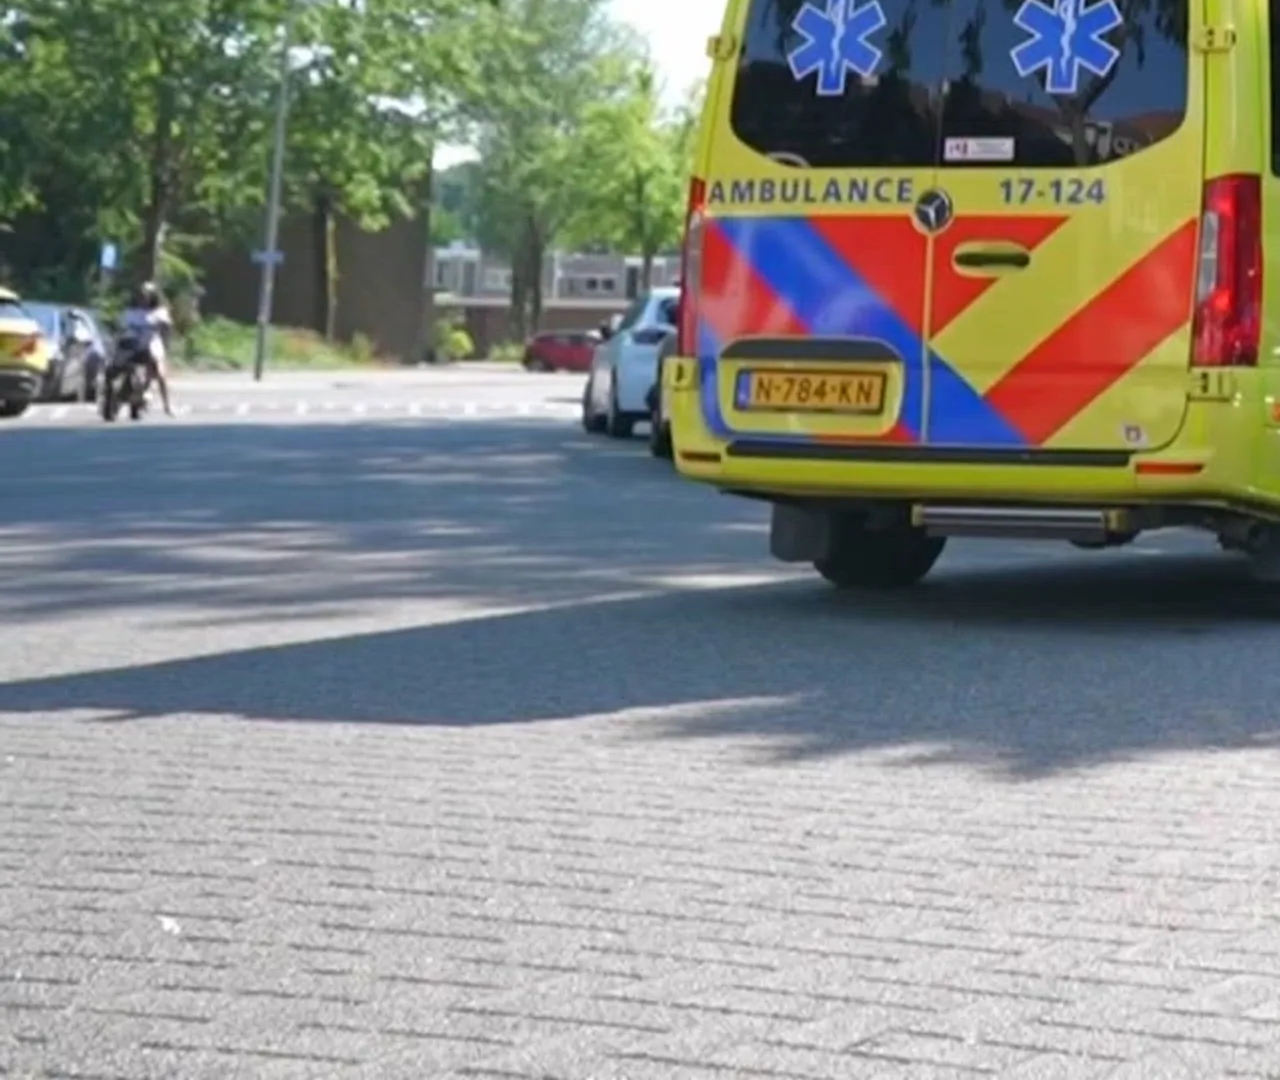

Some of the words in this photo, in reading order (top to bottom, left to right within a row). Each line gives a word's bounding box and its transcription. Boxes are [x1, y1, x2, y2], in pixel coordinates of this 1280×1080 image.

[708, 177, 914, 204] AMBULANCE
[999, 178, 1106, 204] 17-124
[756, 376, 874, 404] N-784-KN
